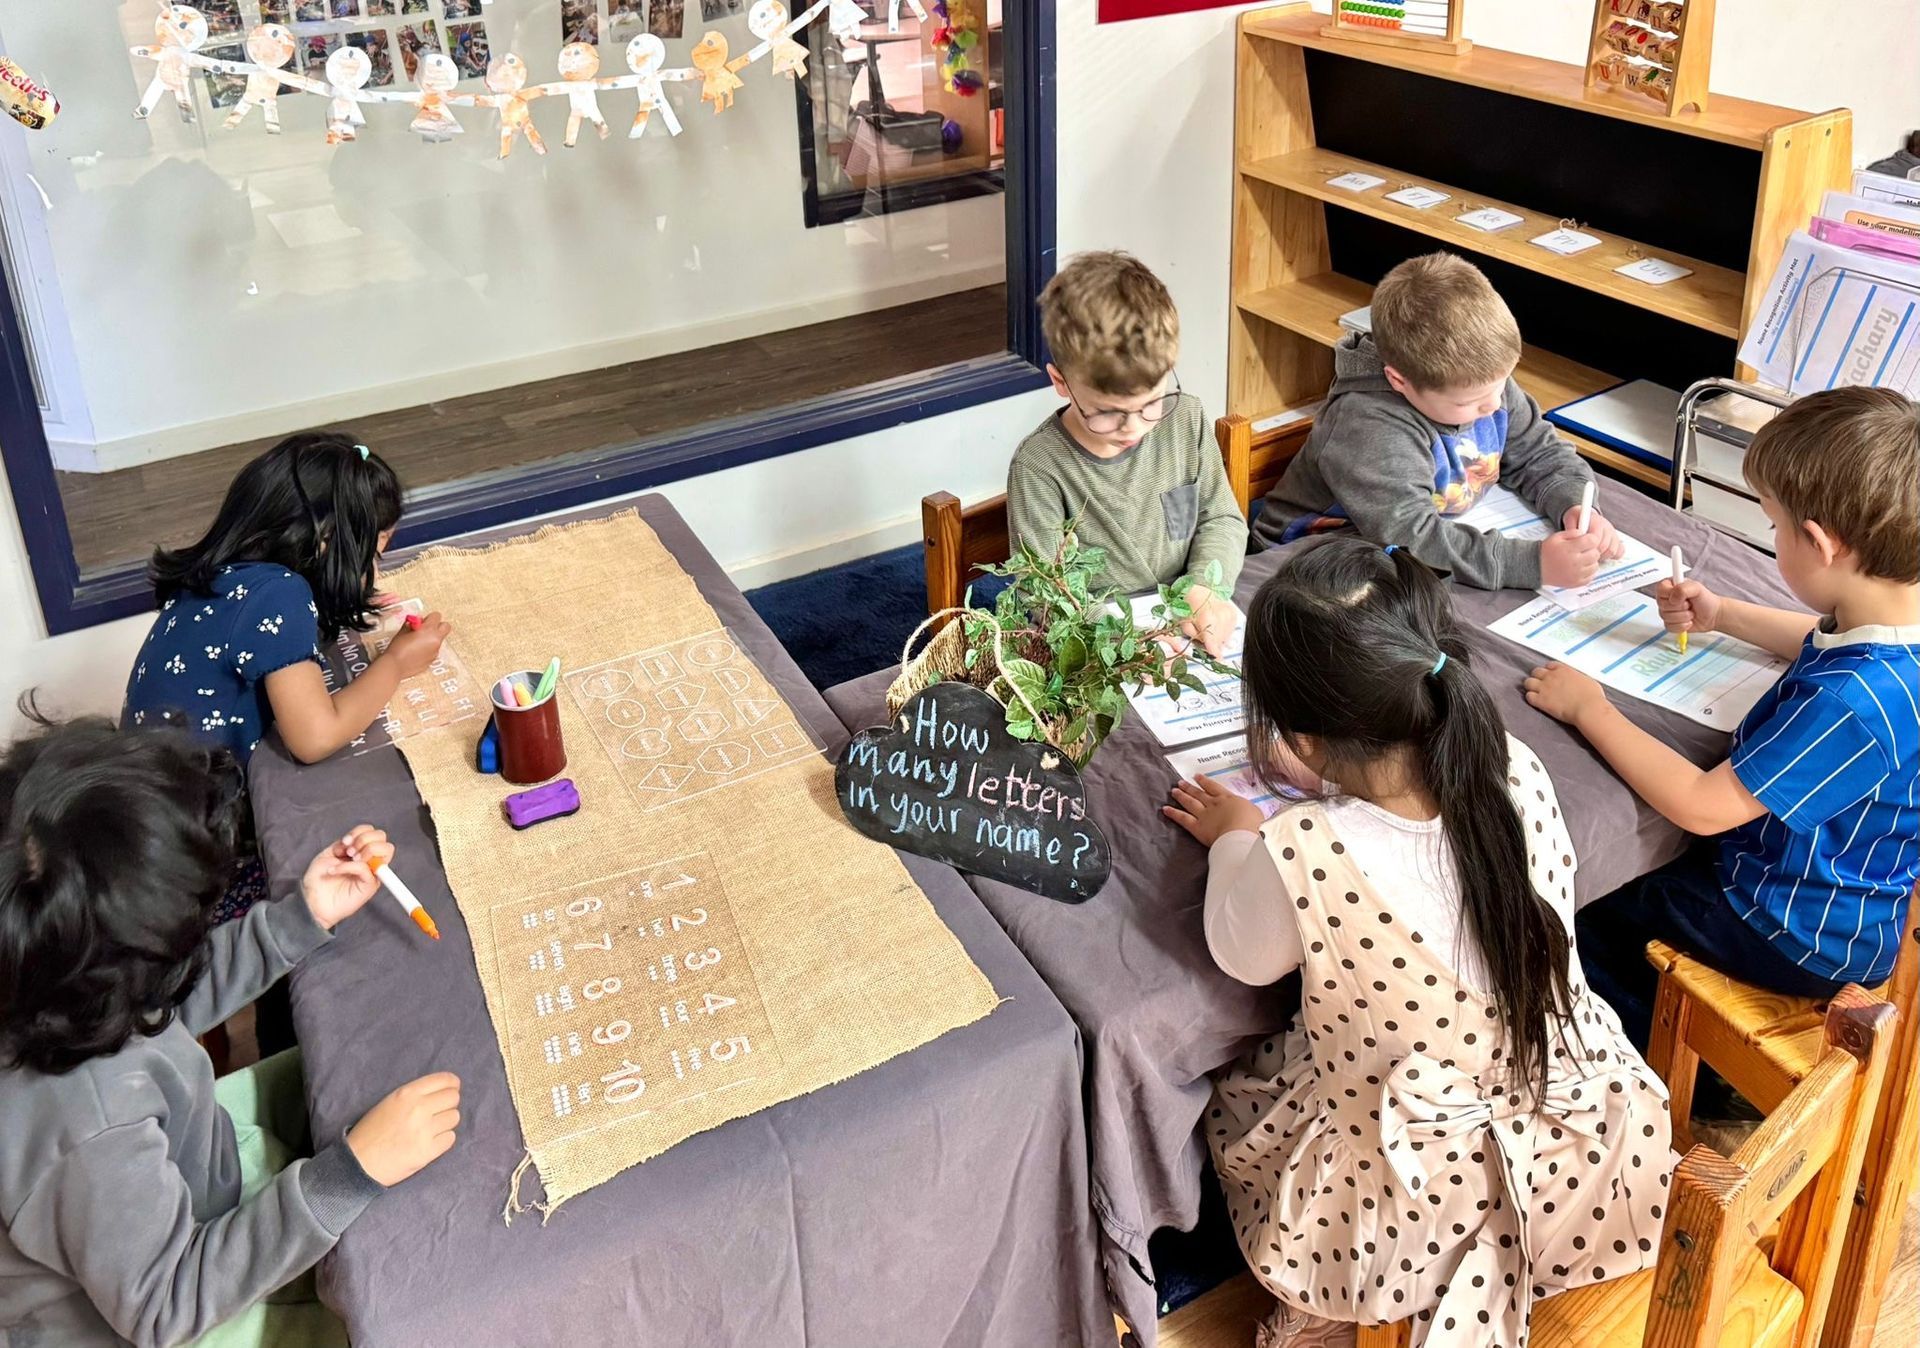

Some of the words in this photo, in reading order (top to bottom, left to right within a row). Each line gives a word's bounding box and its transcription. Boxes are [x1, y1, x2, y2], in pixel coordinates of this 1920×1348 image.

[1858, 218, 1869, 228] Use
[1870, 222, 1887, 232] your
[1758, 331, 1768, 345] Name
[1765, 294, 1782, 328] Recognition
[1780, 270, 1794, 295] Activity
[1790, 258, 1798, 271] Mat
[1842, 307, 1900, 389] achary
[341, 644, 359, 662] Nn
[382, 720, 404, 734] Rr
[440, 678, 458, 694] Ee
[453, 697, 474, 711] Ff
[915, 697, 989, 754] How
[1198, 752, 1222, 764] Name
[848, 742, 958, 798] many
[966, 763, 1086, 821] letters
[891, 793, 963, 834] your
[662, 874, 698, 890] 1
[566, 897, 602, 916] 6
[671, 908, 708, 932] 2
[574, 932, 613, 950] 7
[684, 948, 721, 970] 3
[582, 976, 622, 1000] 8
[641, 880, 654, 898] one
[650, 918, 664, 938] two
[662, 954, 678, 984] three
[675, 1000, 690, 1024] four
[688, 1048, 702, 1071] five
[544, 908, 556, 922] six
[550, 940, 565, 972] seven
[558, 985, 576, 1012] eight
[568, 1032, 582, 1057] nine
[578, 1082, 592, 1104] ten
[696, 993, 736, 1015] 4
[592, 1020, 632, 1044] 9
[710, 1036, 751, 1061] 5
[601, 1059, 646, 1104] 10
